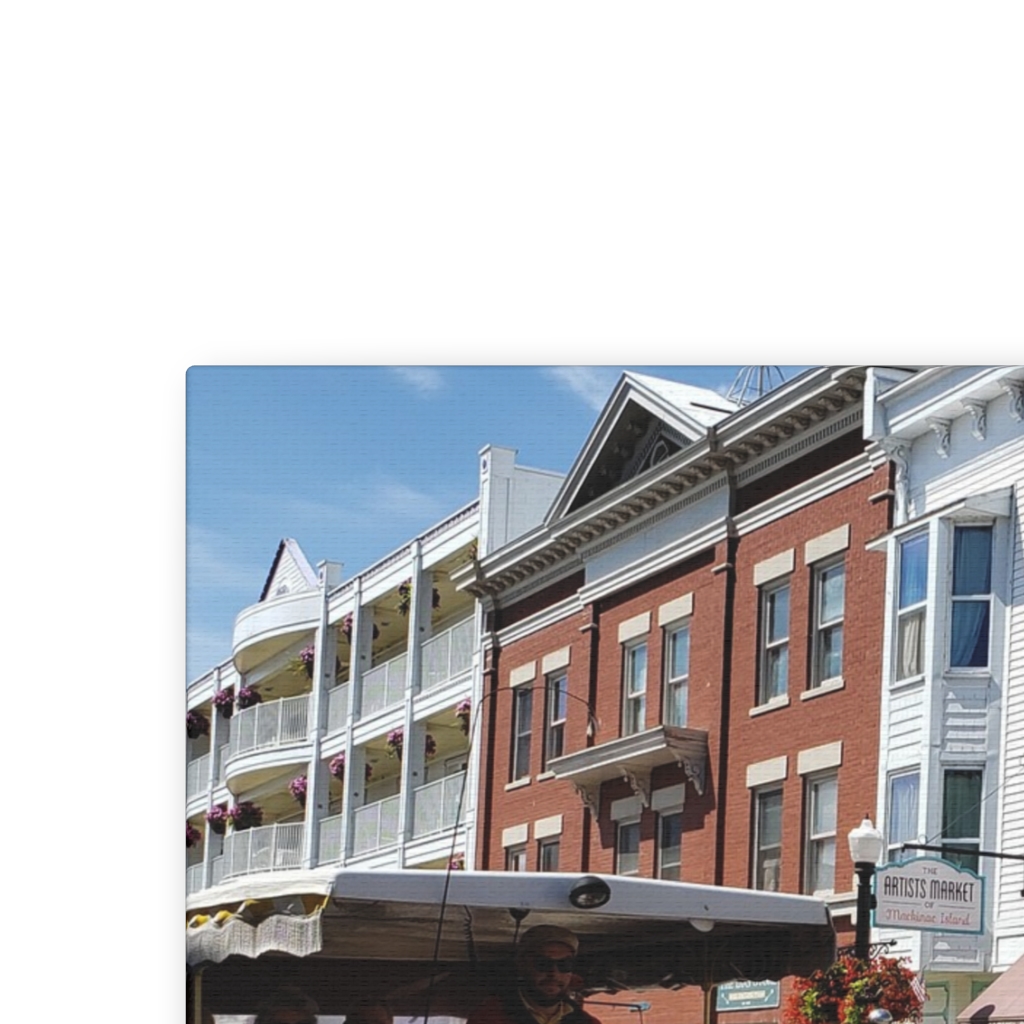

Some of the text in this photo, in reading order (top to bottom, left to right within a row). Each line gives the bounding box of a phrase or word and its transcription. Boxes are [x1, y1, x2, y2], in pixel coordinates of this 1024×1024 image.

[922, 867, 938, 875] THE
[884, 876, 975, 903] ARTISTS MARKET
[885, 908, 971, 926] Mackinac Island
